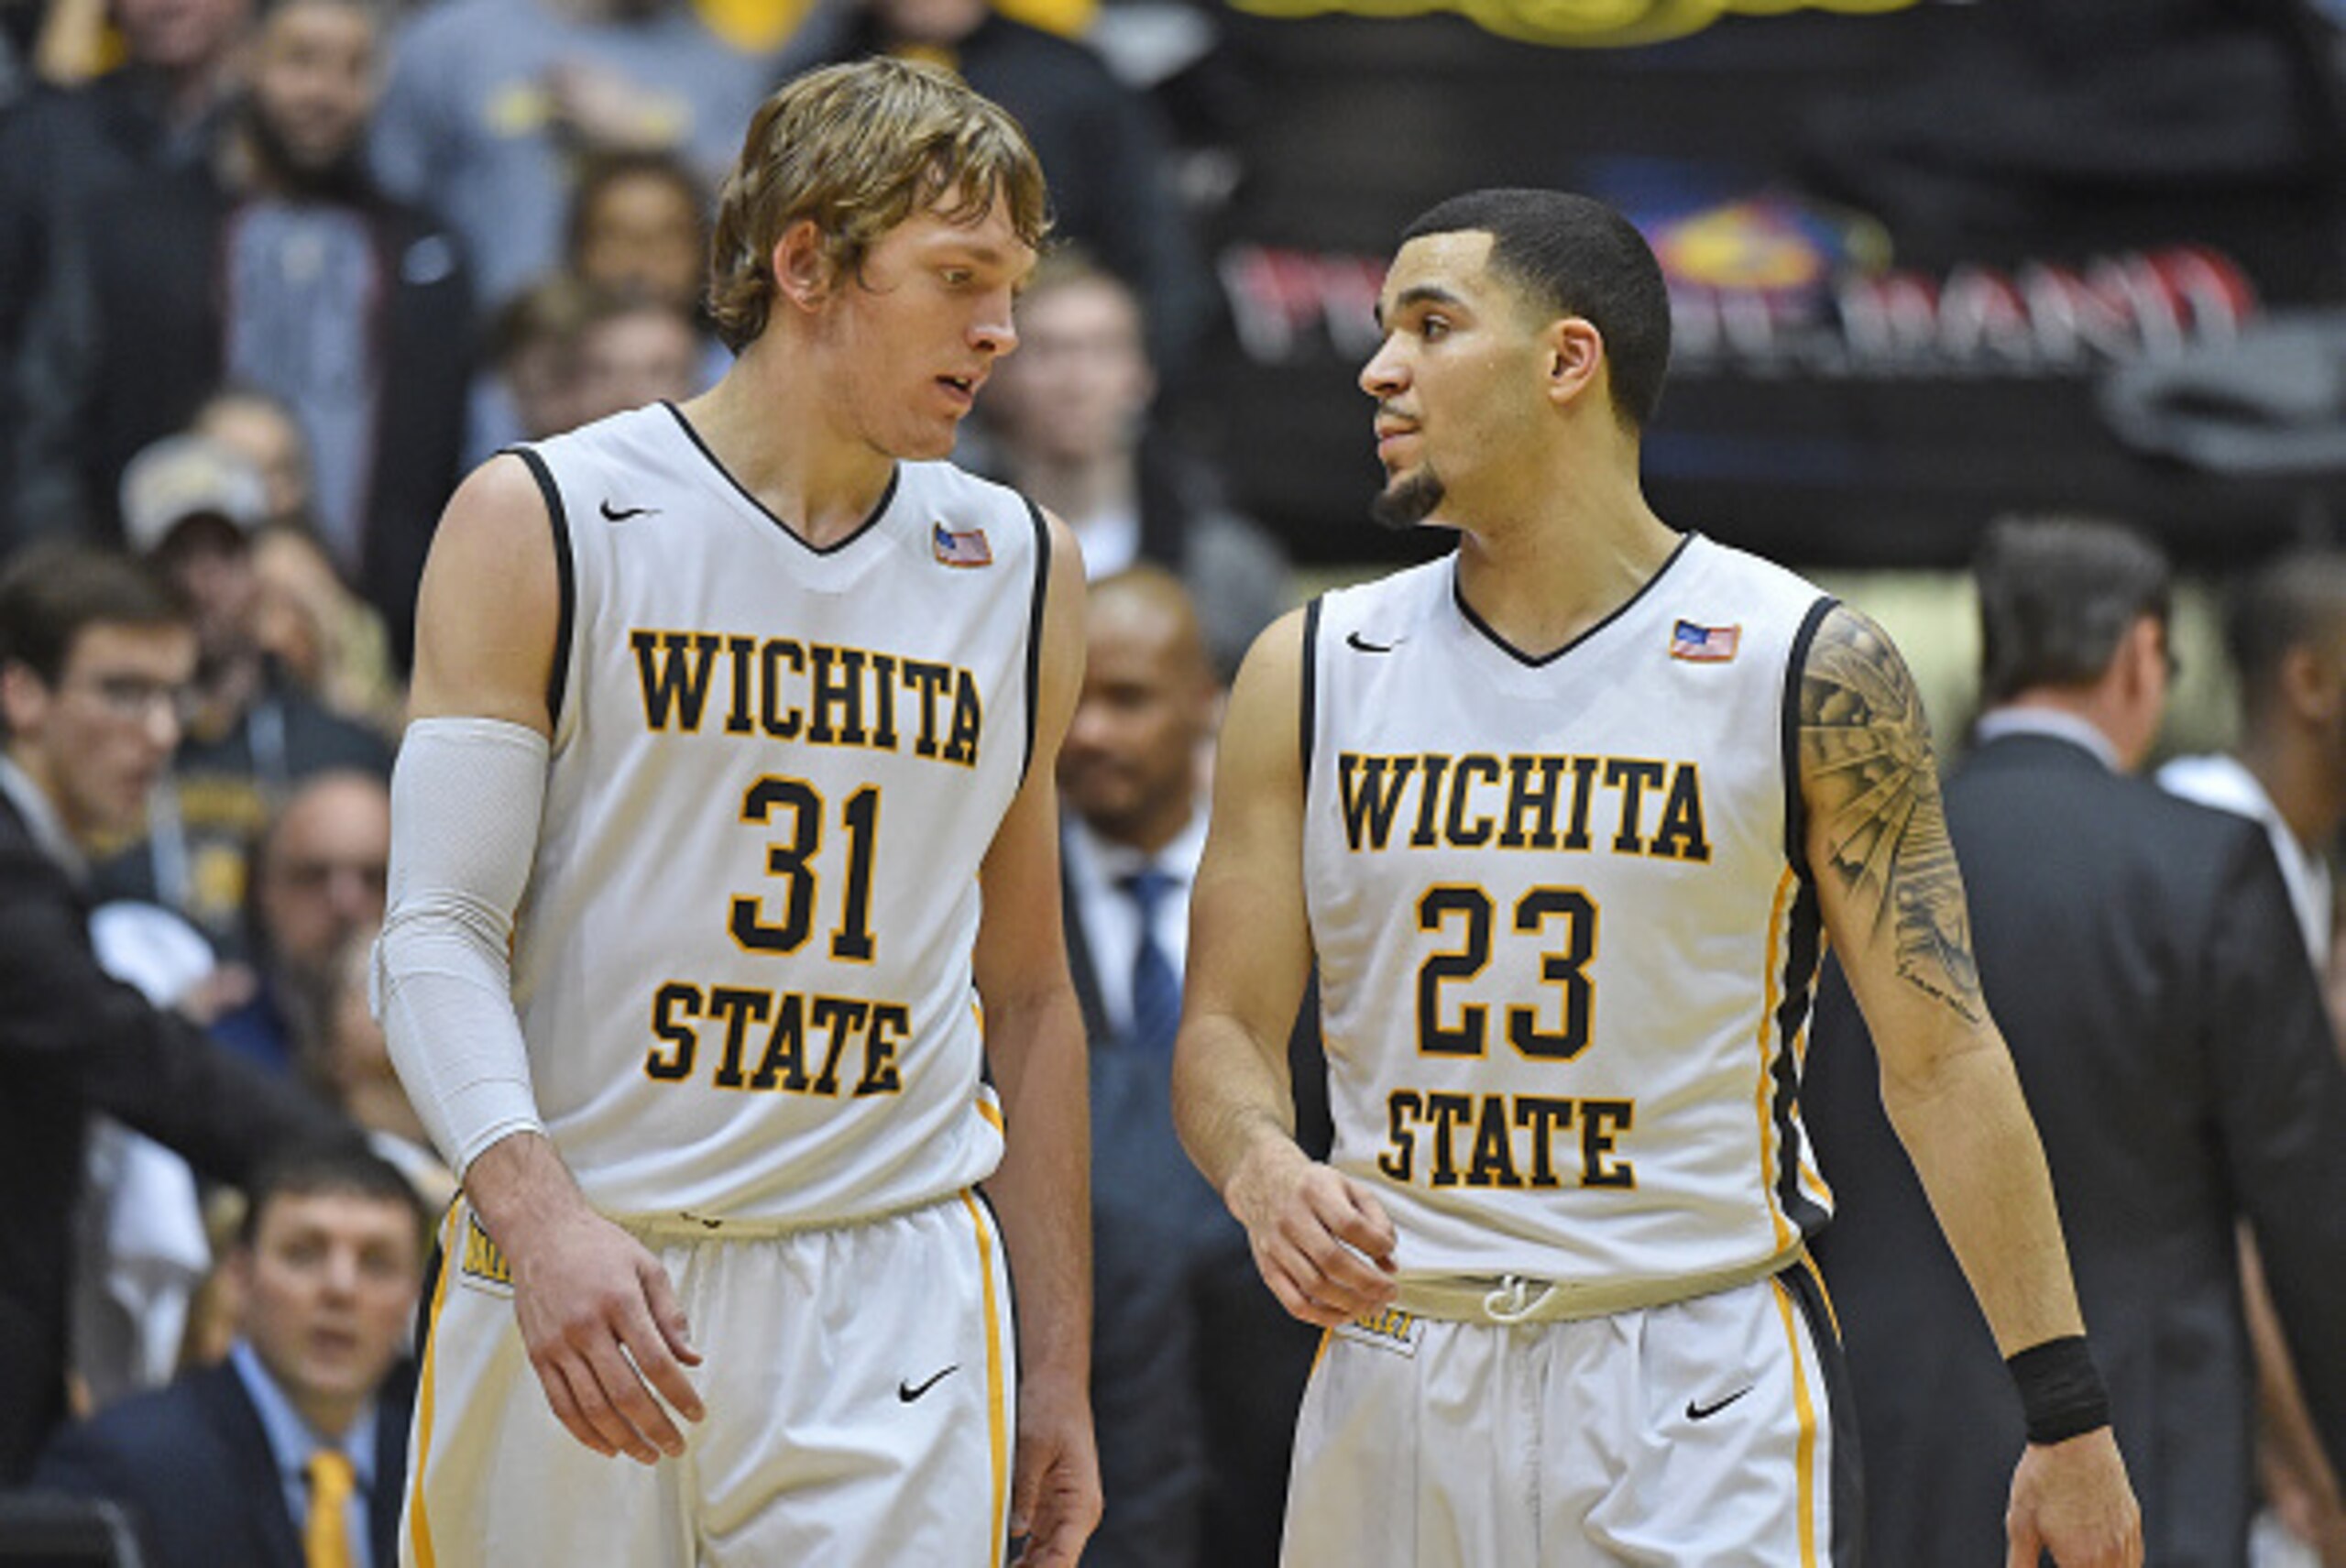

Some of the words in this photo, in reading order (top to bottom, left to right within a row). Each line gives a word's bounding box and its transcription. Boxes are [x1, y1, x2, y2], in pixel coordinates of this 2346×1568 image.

[630, 630, 982, 768] WICHITA
[728, 774, 881, 965] 31
[1338, 752, 1711, 864] WICHITA
[1416, 882, 1600, 1061] 23
[645, 981, 911, 1097] STATE
[1378, 1089, 1637, 1190] STATE
